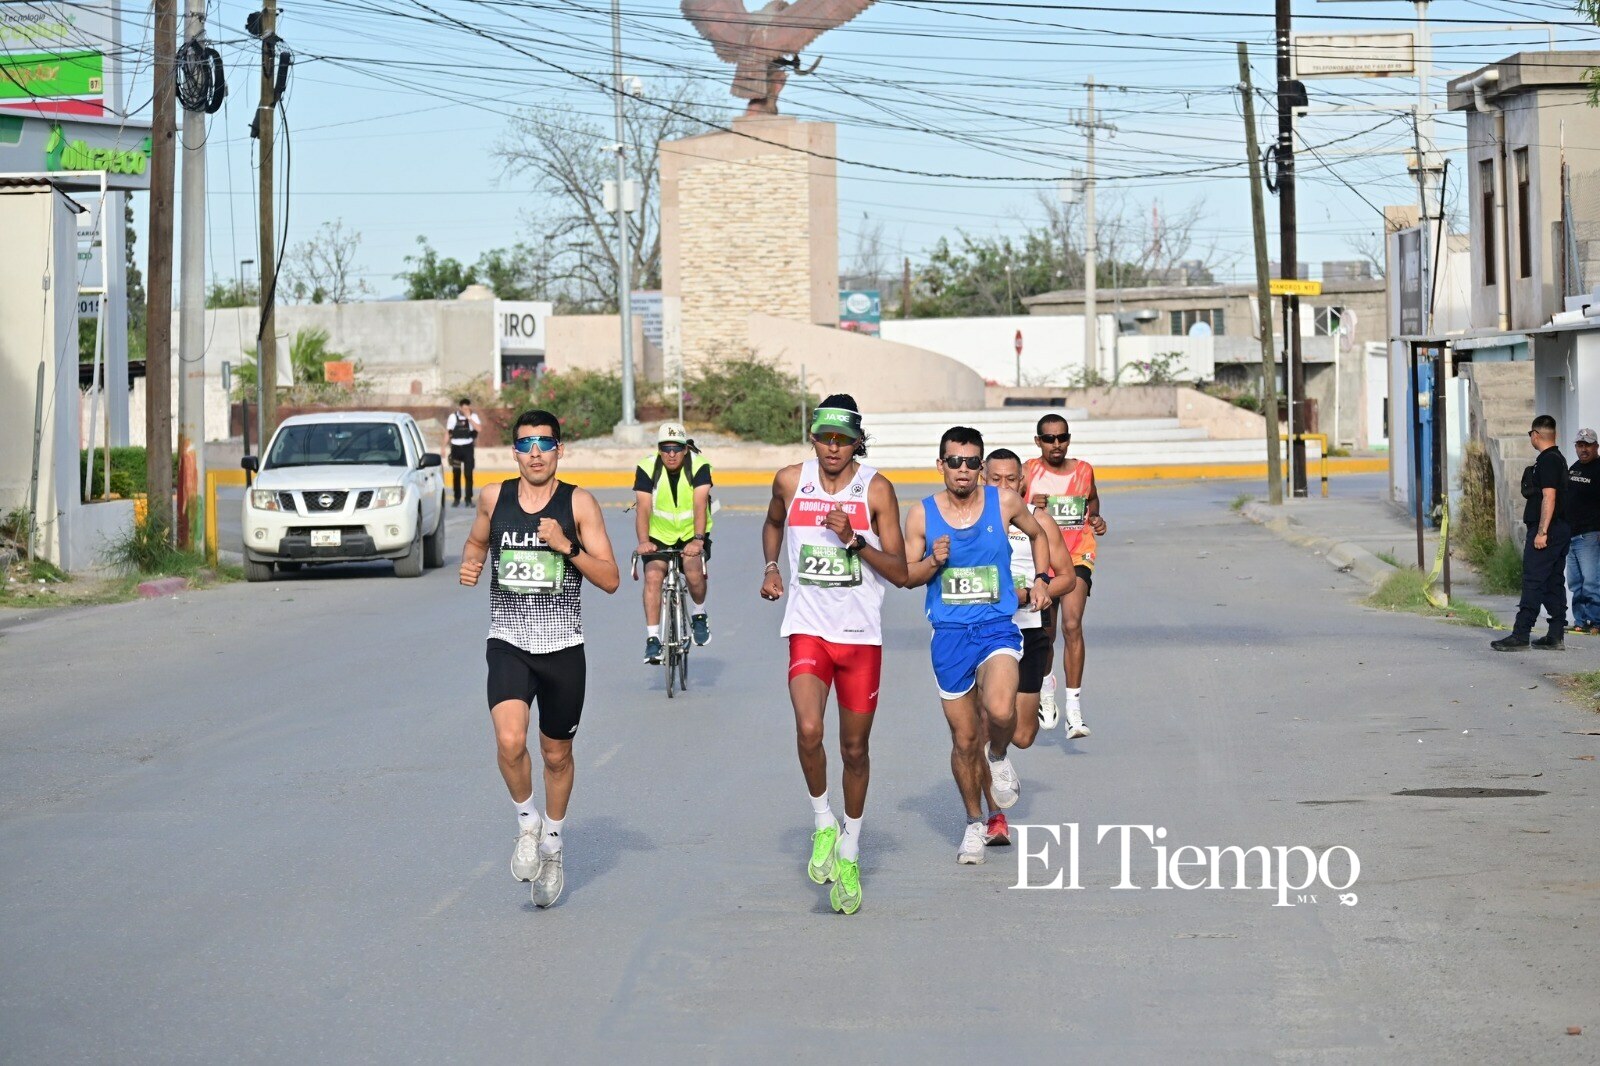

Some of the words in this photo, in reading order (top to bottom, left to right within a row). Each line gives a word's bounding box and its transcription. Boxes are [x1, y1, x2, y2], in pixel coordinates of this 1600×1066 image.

[90, 80, 99, 89] 87
[500, 313, 536, 337] IRO
[799, 501, 830, 513] RODOLFO
[1053, 503, 1077, 516] 146
[504, 561, 546, 581] 238
[804, 556, 845, 576] 225
[948, 577, 984, 594] 185
